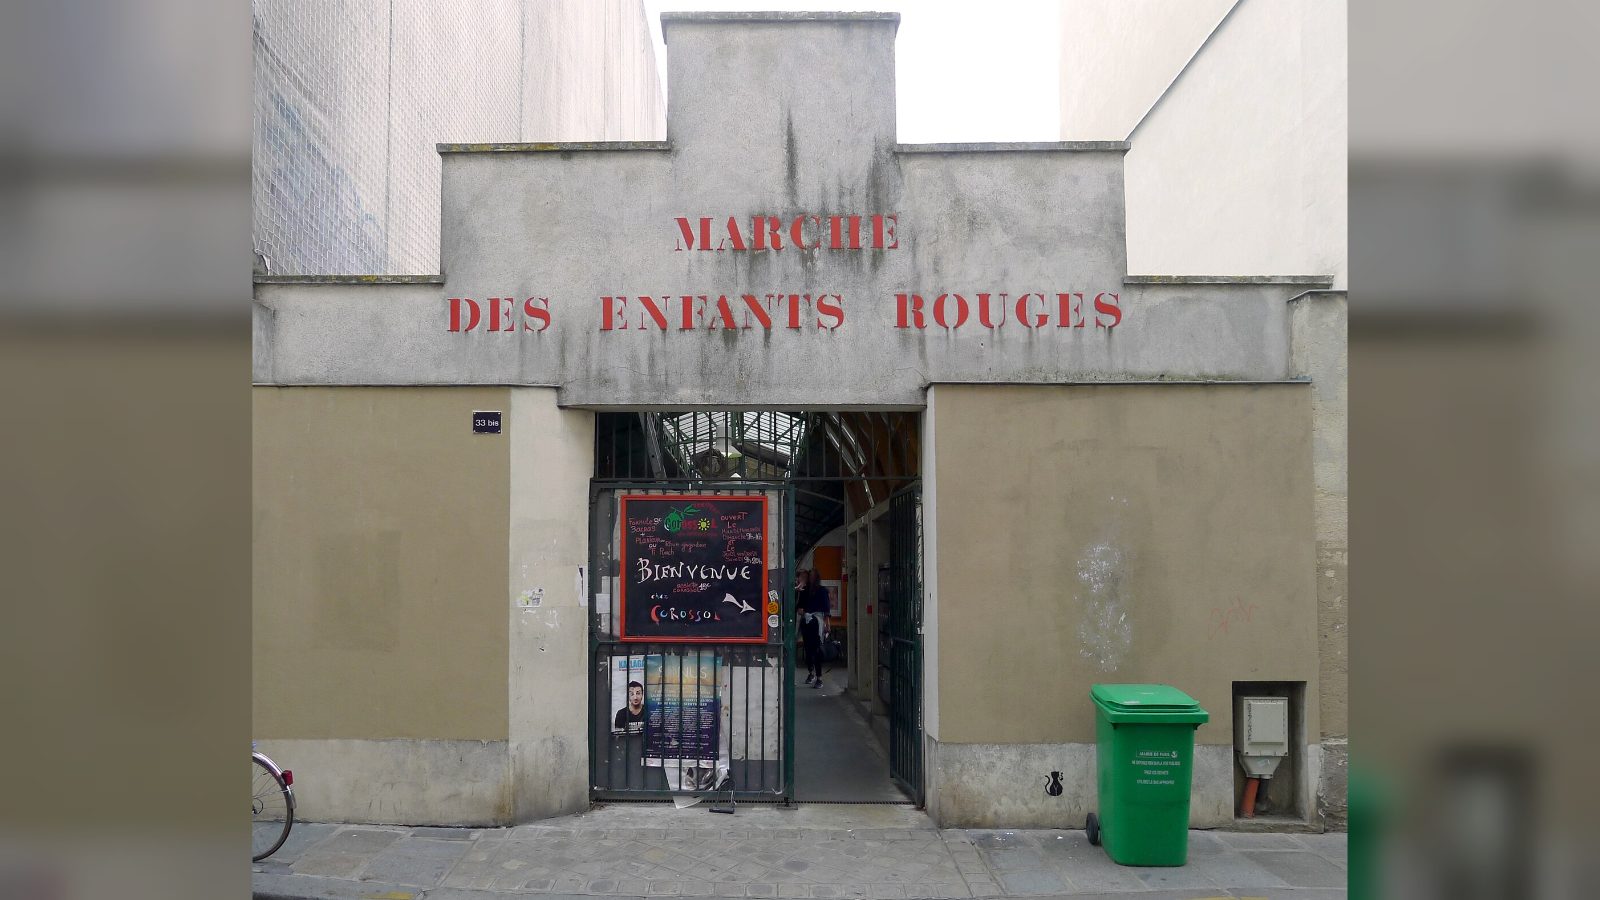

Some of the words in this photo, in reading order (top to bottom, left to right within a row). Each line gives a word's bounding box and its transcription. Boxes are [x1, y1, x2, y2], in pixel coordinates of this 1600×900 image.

[676, 215, 897, 251] MARCHE
[448, 298, 551, 332] DES
[601, 295, 844, 331] ENFANTS
[895, 293, 1121, 328] ROUGES
[475, 419, 486, 427] 33
[487, 419, 499, 427] bis
[637, 557, 751, 584] BIENVENUE
